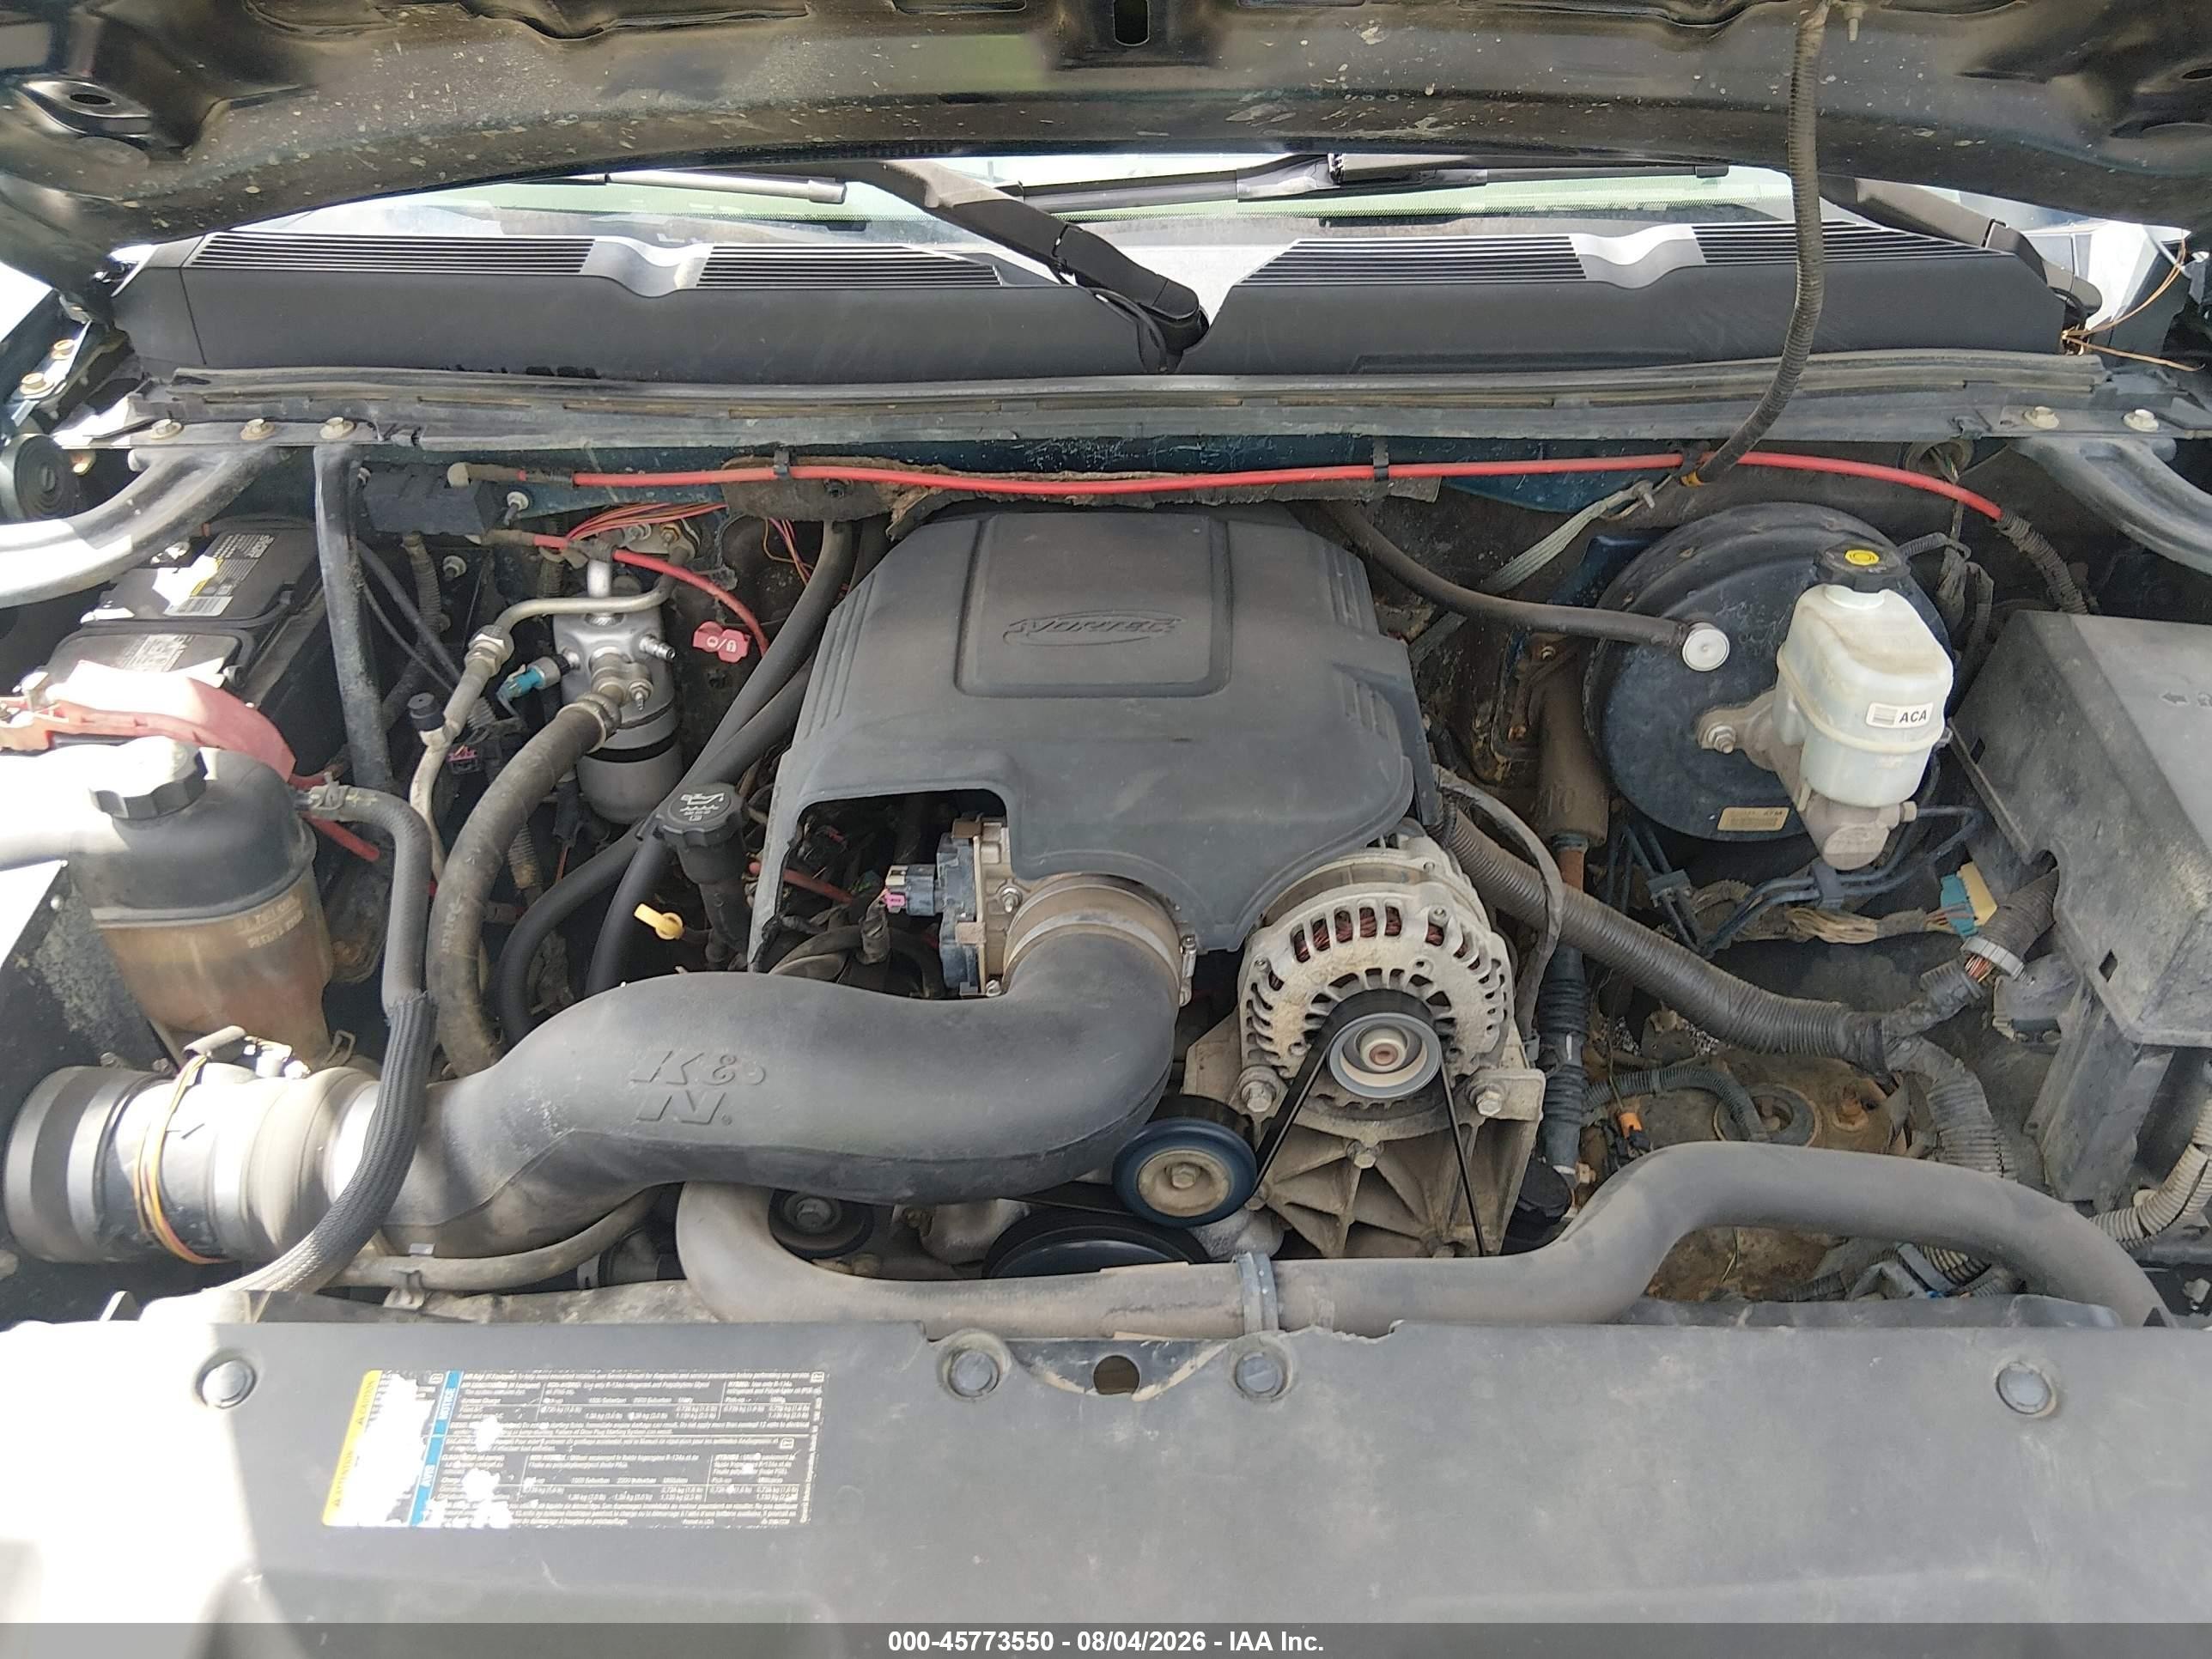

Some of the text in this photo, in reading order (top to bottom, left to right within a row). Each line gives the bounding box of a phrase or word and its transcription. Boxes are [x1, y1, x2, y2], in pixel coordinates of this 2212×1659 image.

[1899, 709, 1928, 723] ACA
[438, 1387, 456, 1420] NOTICE
[419, 1464, 435, 1488] AVIS
